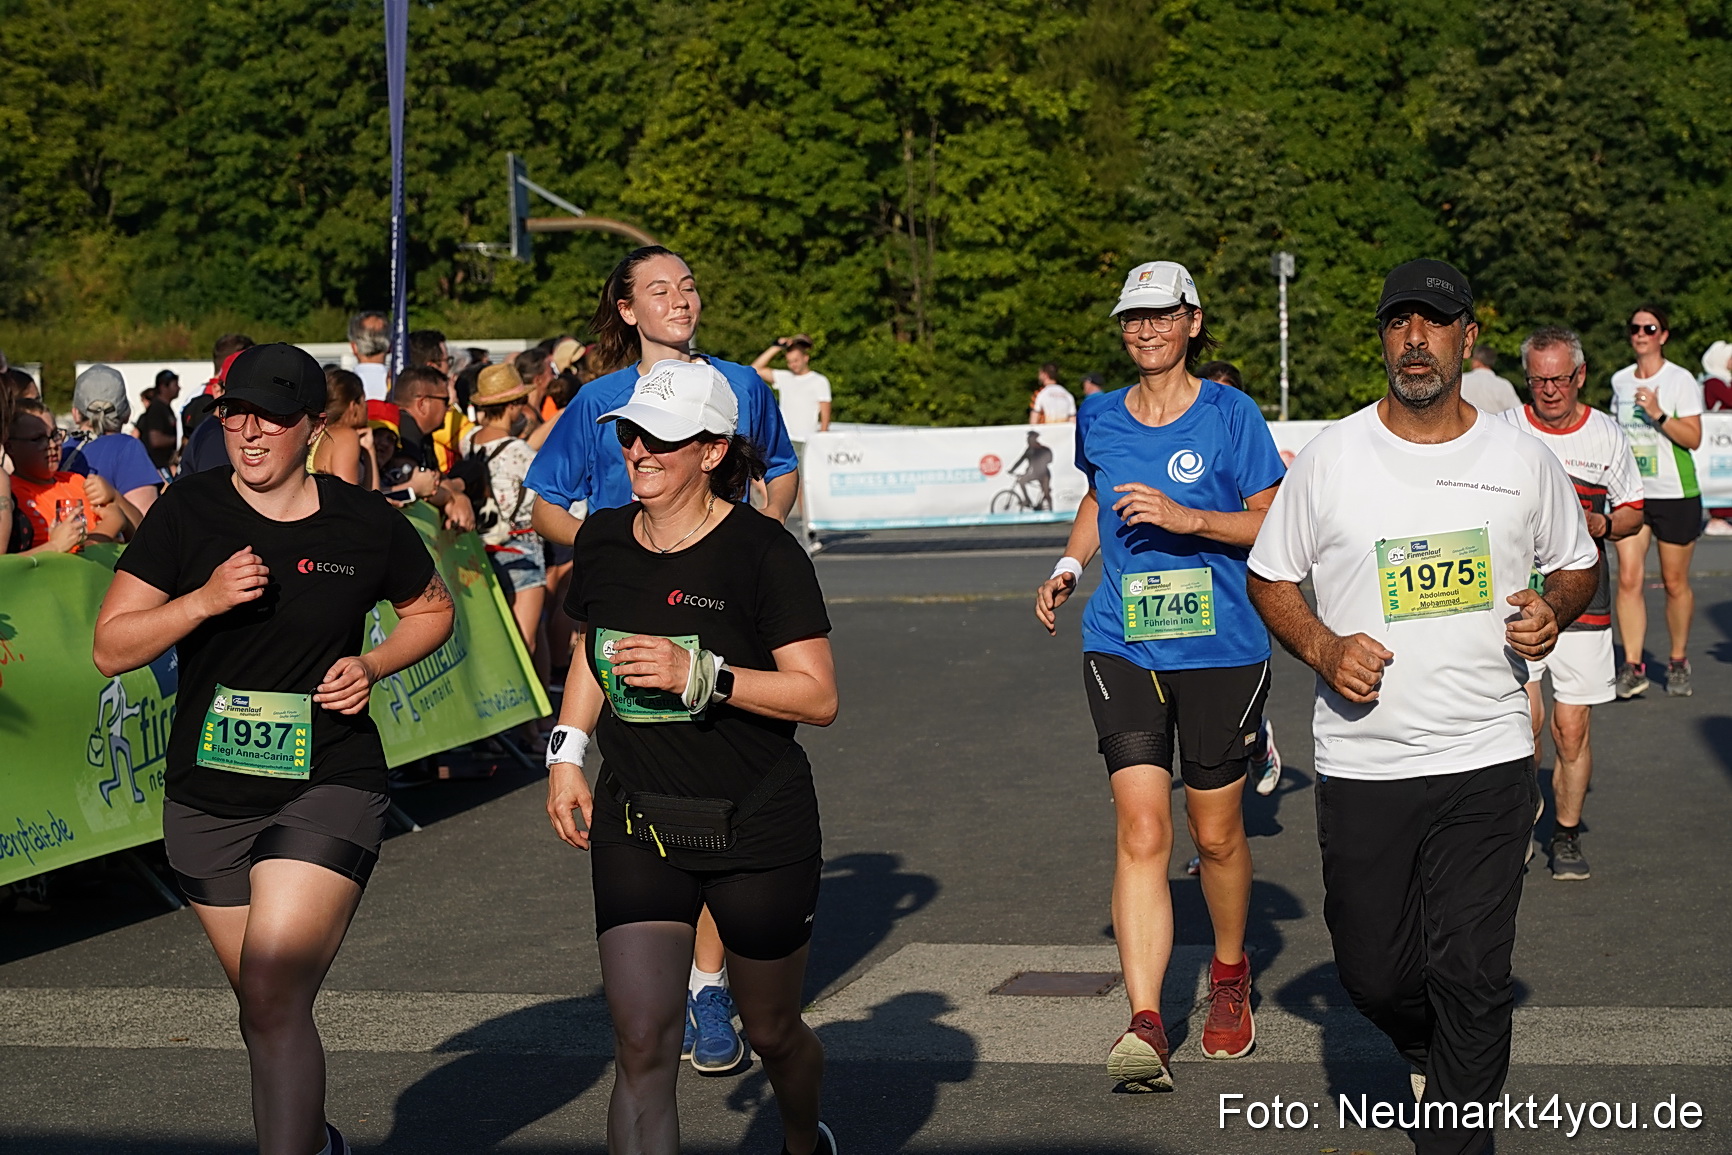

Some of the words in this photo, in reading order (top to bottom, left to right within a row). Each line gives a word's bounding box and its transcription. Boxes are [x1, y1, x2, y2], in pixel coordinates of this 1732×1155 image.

[1565, 459, 1602, 470] NEUMARKT
[1436, 480, 1479, 489] Mohammad
[1481, 484, 1521, 496] Abdolmouti
[1407, 548, 1441, 559] Firmenlauf
[316, 562, 355, 576] ECOVIS
[1400, 558, 1475, 592] 1975
[1477, 561, 1488, 598] 2022
[1386, 571, 1400, 611] WALK
[1419, 588, 1459, 600] Abdolmouti
[683, 594, 725, 611] ECOVIS
[1137, 592, 1199, 617] 1746
[1200, 594, 1211, 626] 2022
[1420, 597, 1460, 608] Mohammad
[1128, 604, 1137, 628] RUN
[1144, 618, 1178, 627] Führlein
[1180, 617, 1194, 625] Ina
[1089, 659, 1110, 701] SALOMON
[226, 705, 262, 713] Firmenlauf
[613, 693, 644, 707] Bergler
[203, 722, 215, 752] RUN
[216, 717, 293, 750] 1937
[212, 744, 234, 757] Fiegl
[236, 748, 294, 762] Anna-Carina
[294, 728, 306, 767] 2022
